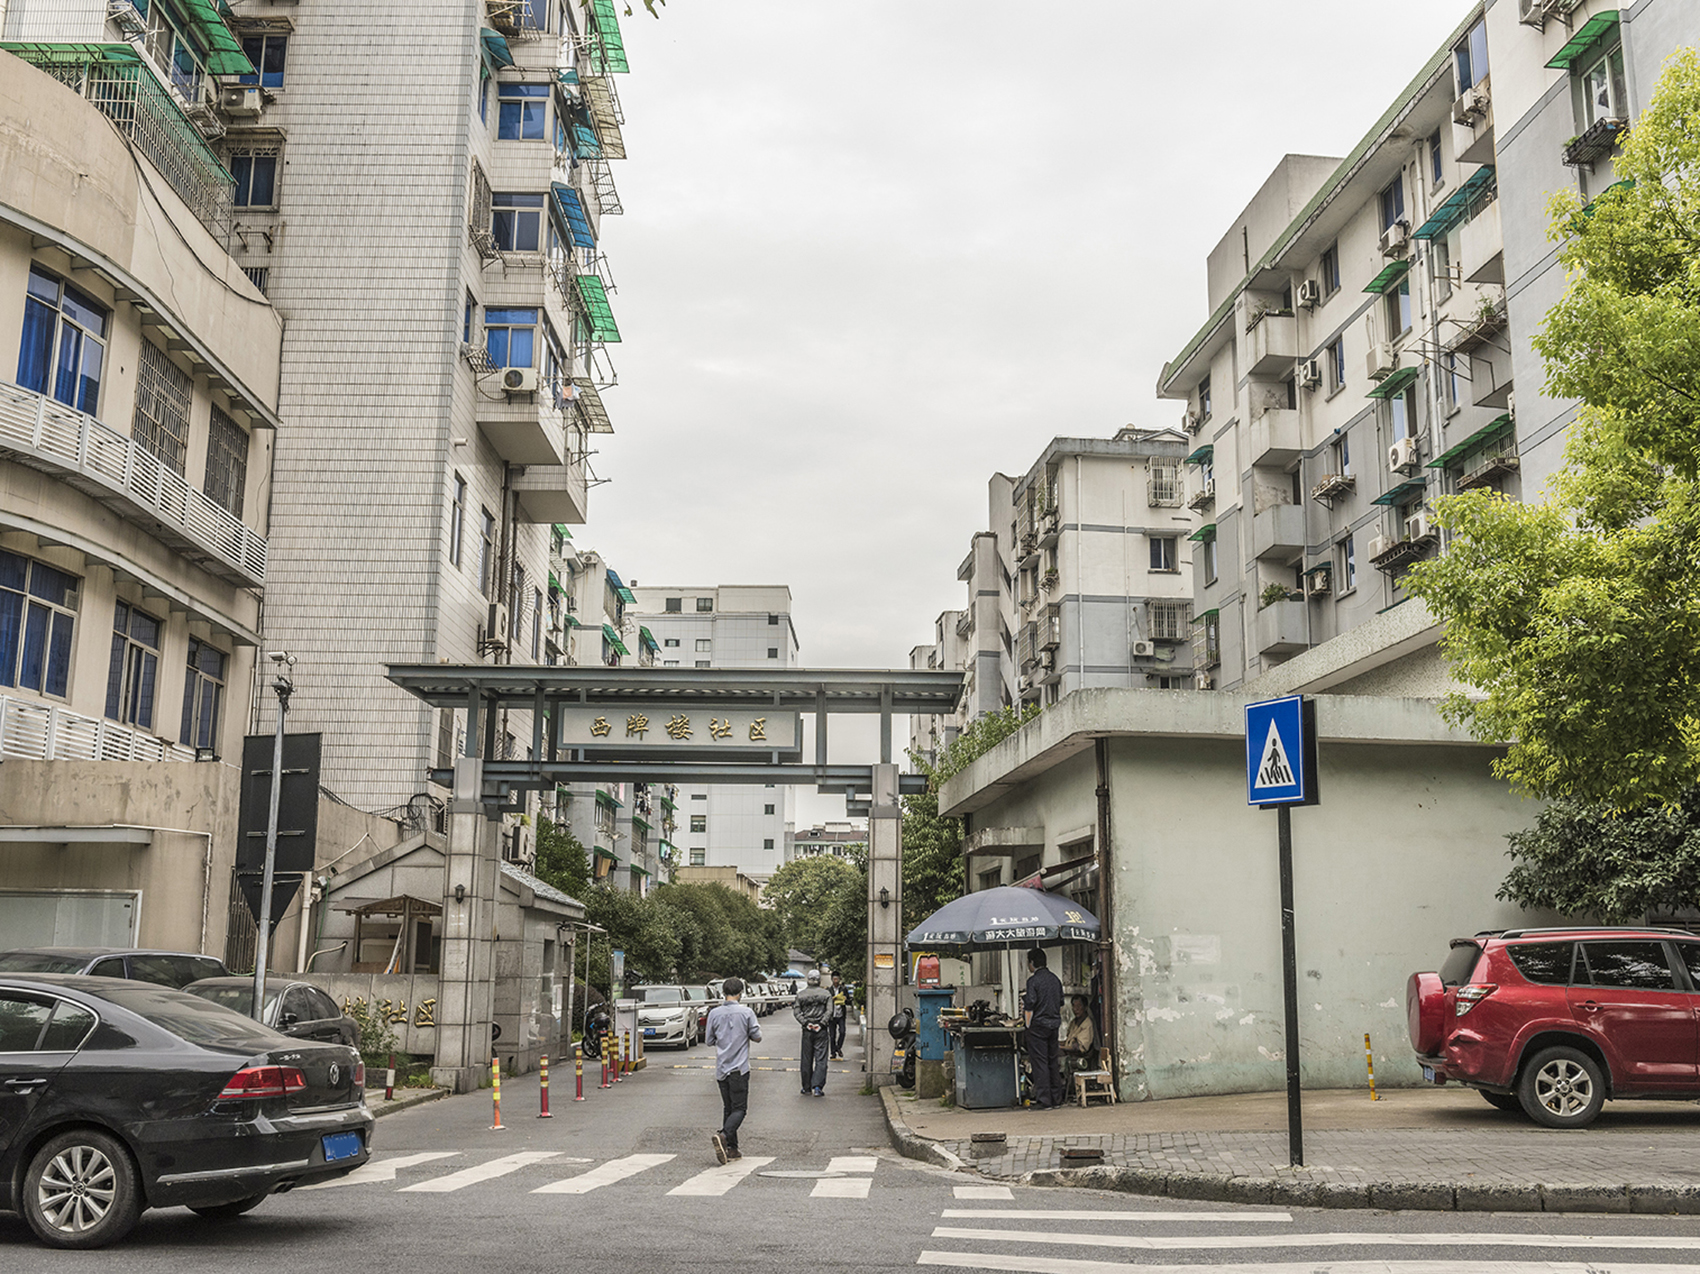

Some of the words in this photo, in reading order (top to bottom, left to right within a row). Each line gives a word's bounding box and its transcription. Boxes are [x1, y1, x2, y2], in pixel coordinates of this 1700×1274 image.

[589, 712, 768, 741] 西牌楼社区
